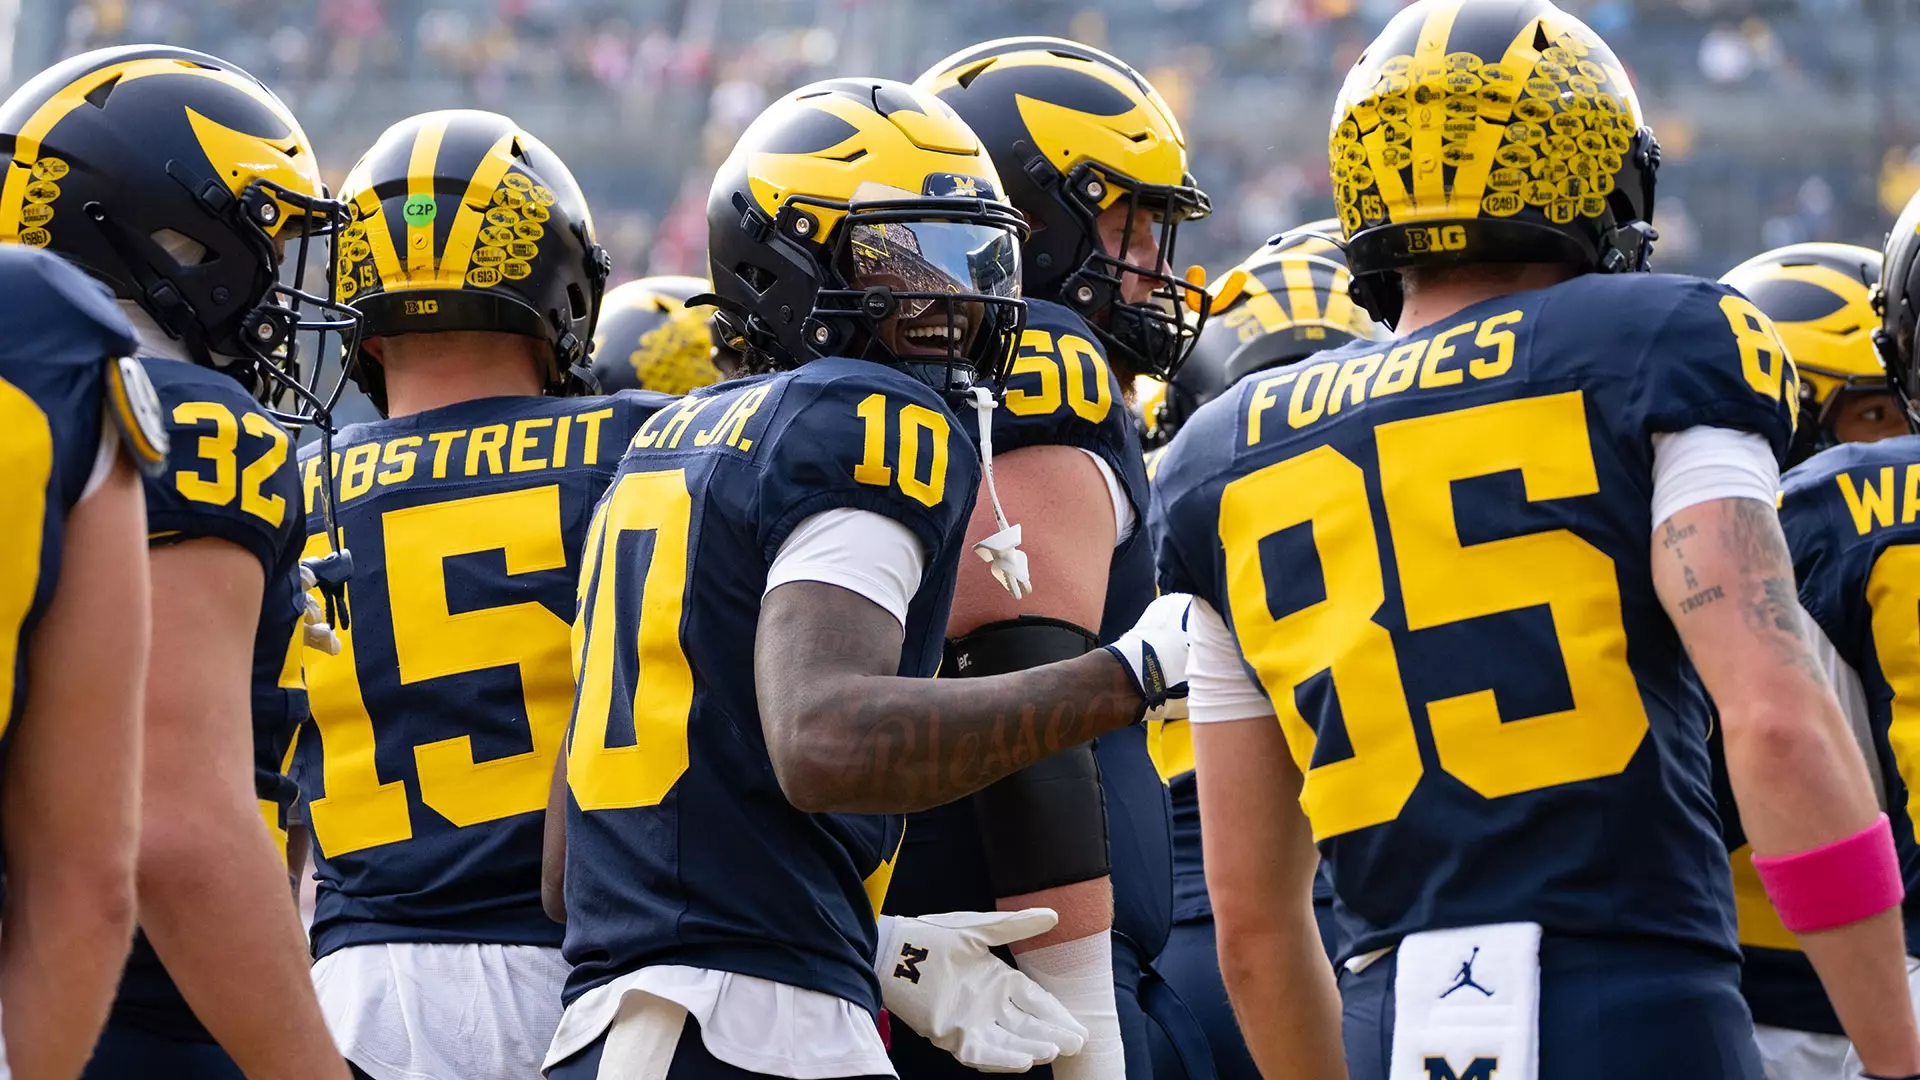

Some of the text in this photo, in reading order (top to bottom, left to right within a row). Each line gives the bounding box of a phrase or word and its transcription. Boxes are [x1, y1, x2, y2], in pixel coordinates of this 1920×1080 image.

[406, 204, 434, 216] C2P
[1361, 195, 1384, 221] 85
[359, 264, 374, 289] 15
[471, 270, 499, 284] (513)
[694, 383, 773, 453] JR.
[1247, 309, 1523, 447] FORBES
[172, 401, 289, 529] 32
[299, 408, 613, 515] RBSTREIT
[853, 393, 951, 507] 10
[1218, 389, 1650, 844] 85
[299, 484, 573, 859] 15
[894, 942, 929, 985] M
